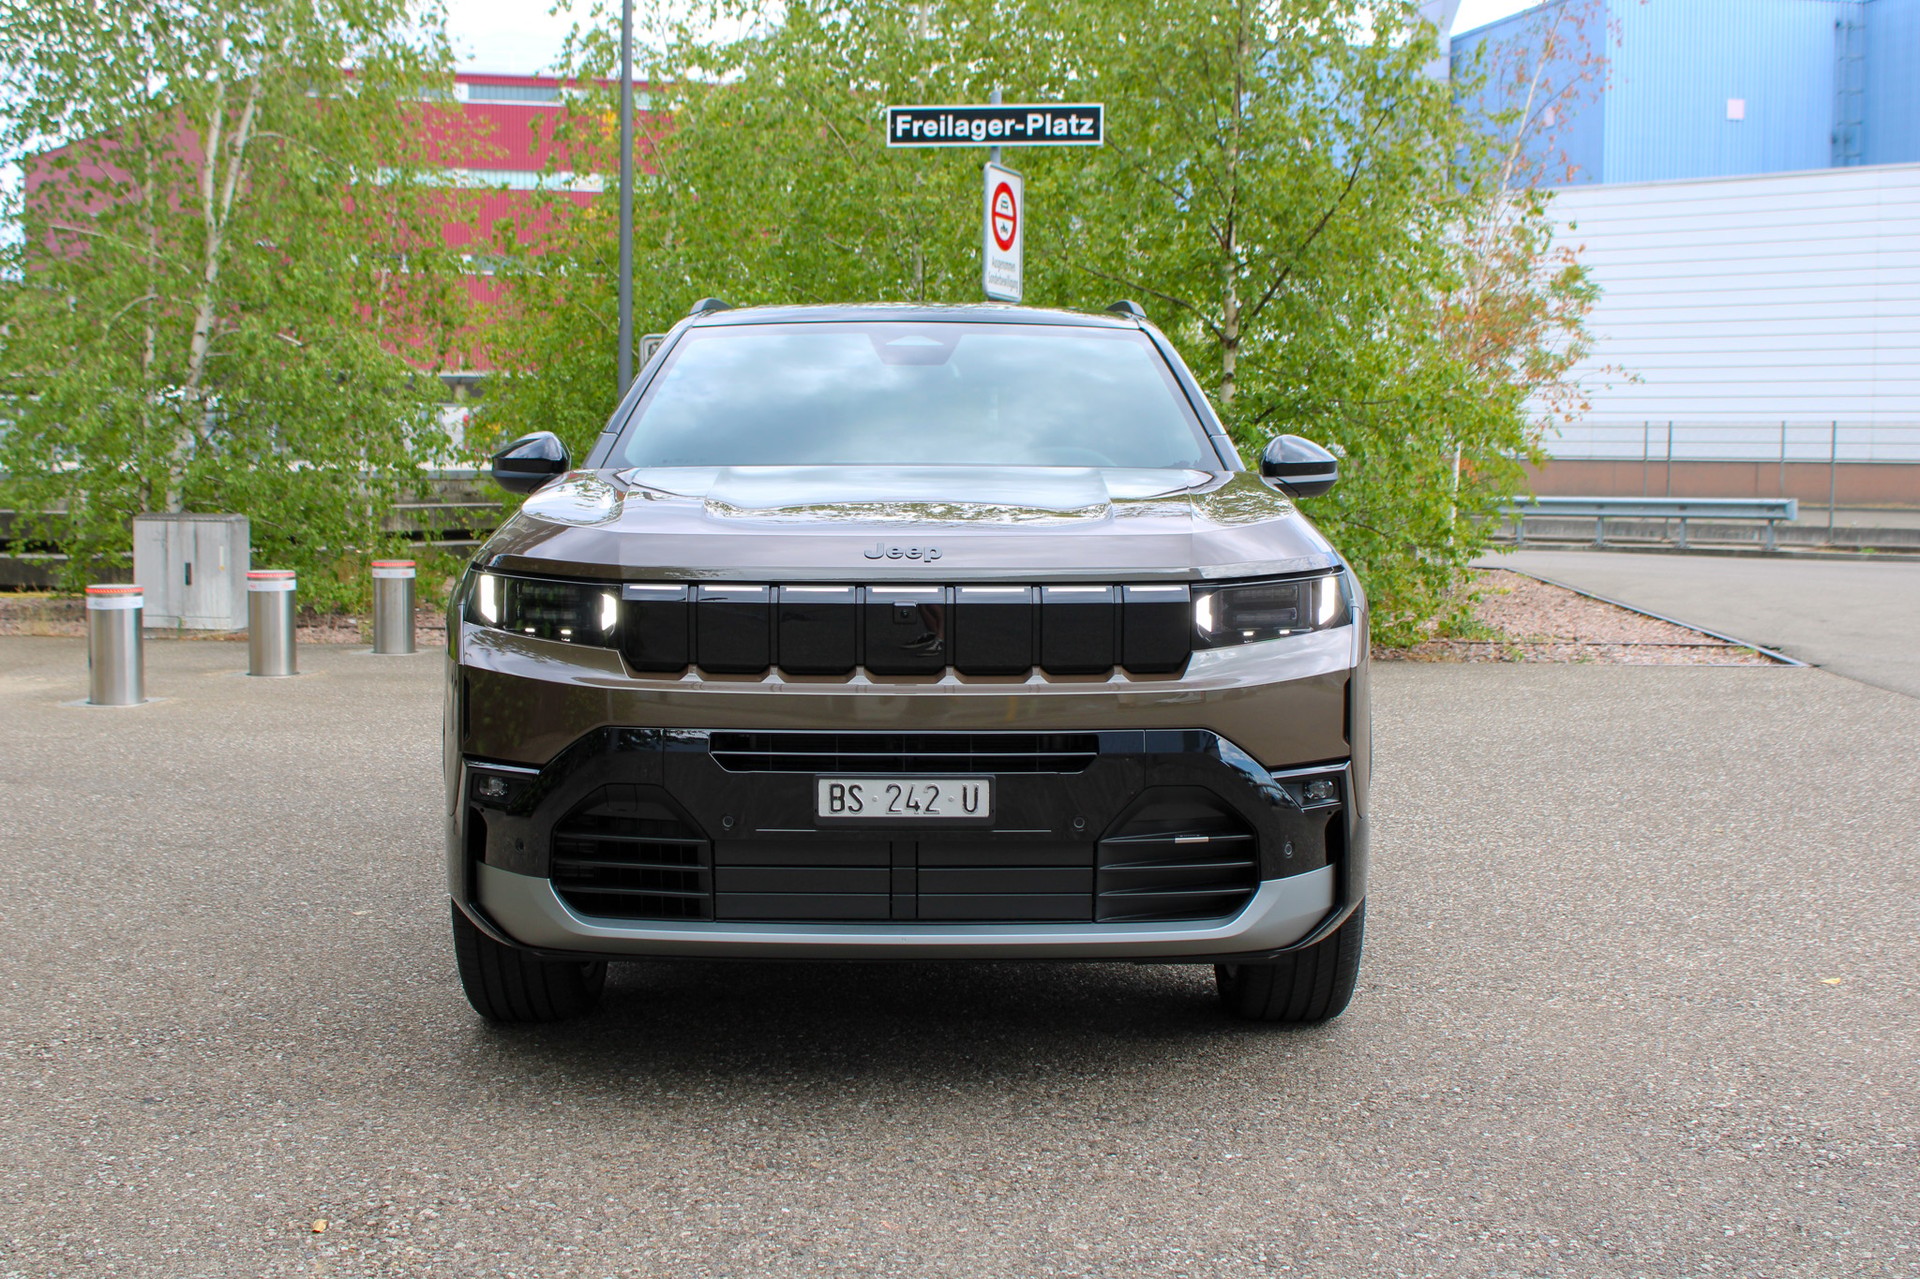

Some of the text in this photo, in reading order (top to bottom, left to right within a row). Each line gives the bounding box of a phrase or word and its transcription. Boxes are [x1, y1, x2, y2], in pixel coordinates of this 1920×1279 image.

[895, 113, 1094, 142] Freilager-Platz
[864, 542, 942, 563] Jeep
[829, 783, 979, 815] BS 242 U
